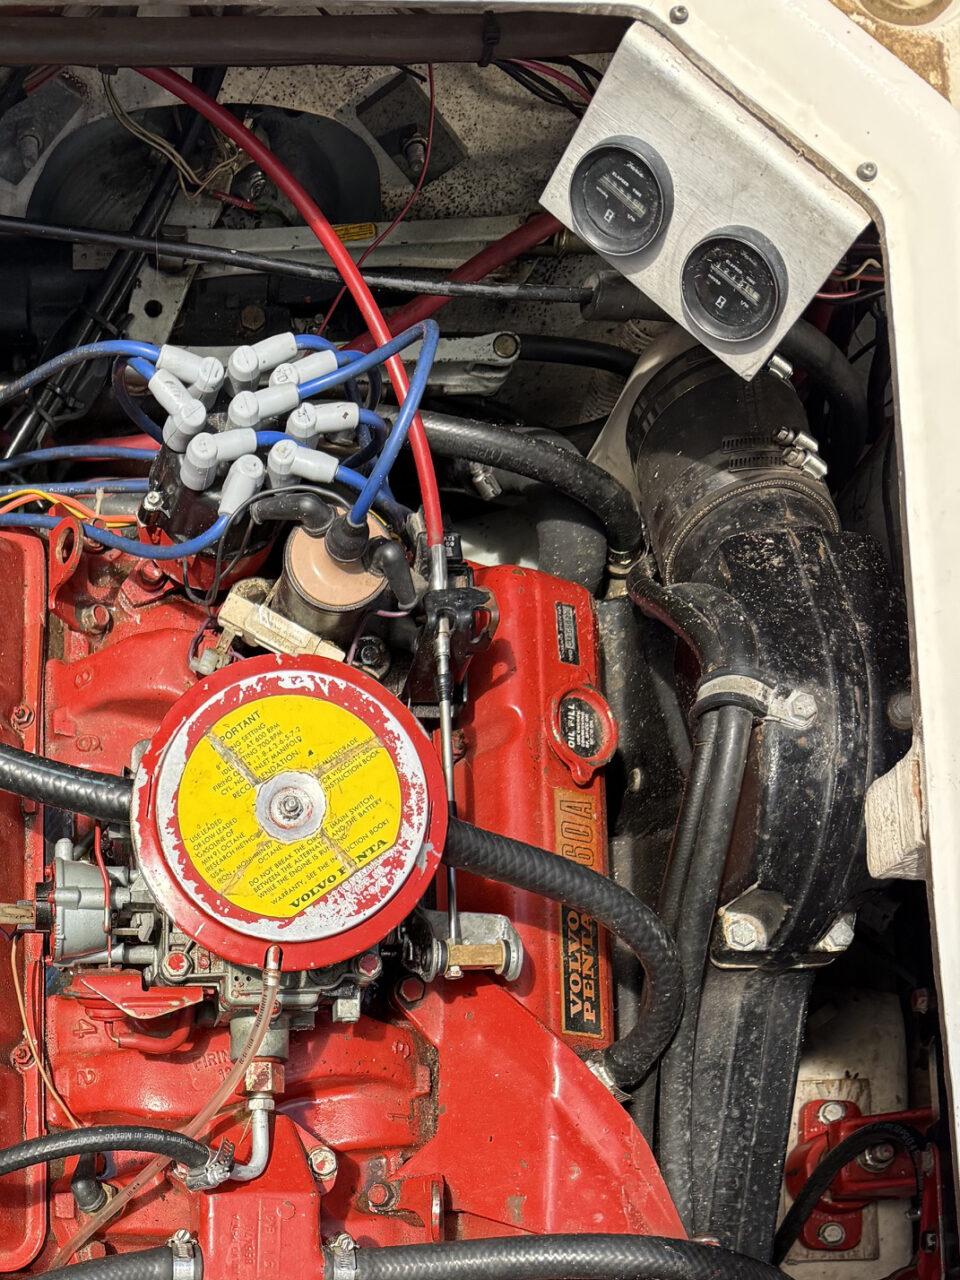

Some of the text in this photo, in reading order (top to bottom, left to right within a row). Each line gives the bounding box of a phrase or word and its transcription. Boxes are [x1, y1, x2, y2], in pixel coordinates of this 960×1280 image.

[210, 709, 260, 751] IPORTANT
[241, 721, 265, 742] SETTING
[245, 740, 254, 749] AT
[254, 731, 266, 742] 600
[266, 721, 280, 734] RPM
[253, 757, 269, 771] INLET
[271, 735, 301, 760] MANIFOLD
[361, 748, 380, 764] BOOK
[189, 816, 222, 843] USE LEADED
[192, 816, 237, 851] OR LOW LEADED
[197, 828, 235, 858] GASOLINE OF
[253, 797, 382, 893] BETWEEN THE ALTERNATO AND THE BATTERY
[560, 797, 593, 867] 60A
[201, 854, 213, 866] MIN
[220, 831, 245, 852] OCTANE
[248, 875, 259, 887] DO
[259, 866, 274, 879] NOT
[273, 852, 293, 869] BREAK
[293, 843, 306, 855] THE
[306, 826, 329, 846] CIRCT
[257, 844, 282, 864] OCTANE
[257, 882, 276, 899] WHILE
[276, 874, 289, 885] THE
[288, 858, 311, 877] ENGINE
[271, 877, 306, 906] WARRANTY,
[305, 869, 318, 881] SEE
[317, 860, 330, 872] THE
[289, 872, 336, 910] VOLVO
[567, 909, 582, 1017] VOLVO
[580, 912, 594, 1024] PENTA
[74, 1018, 102, 1040] 4
[76, 1069, 98, 1088] 2
[143, 1132, 164, 1141] Made
